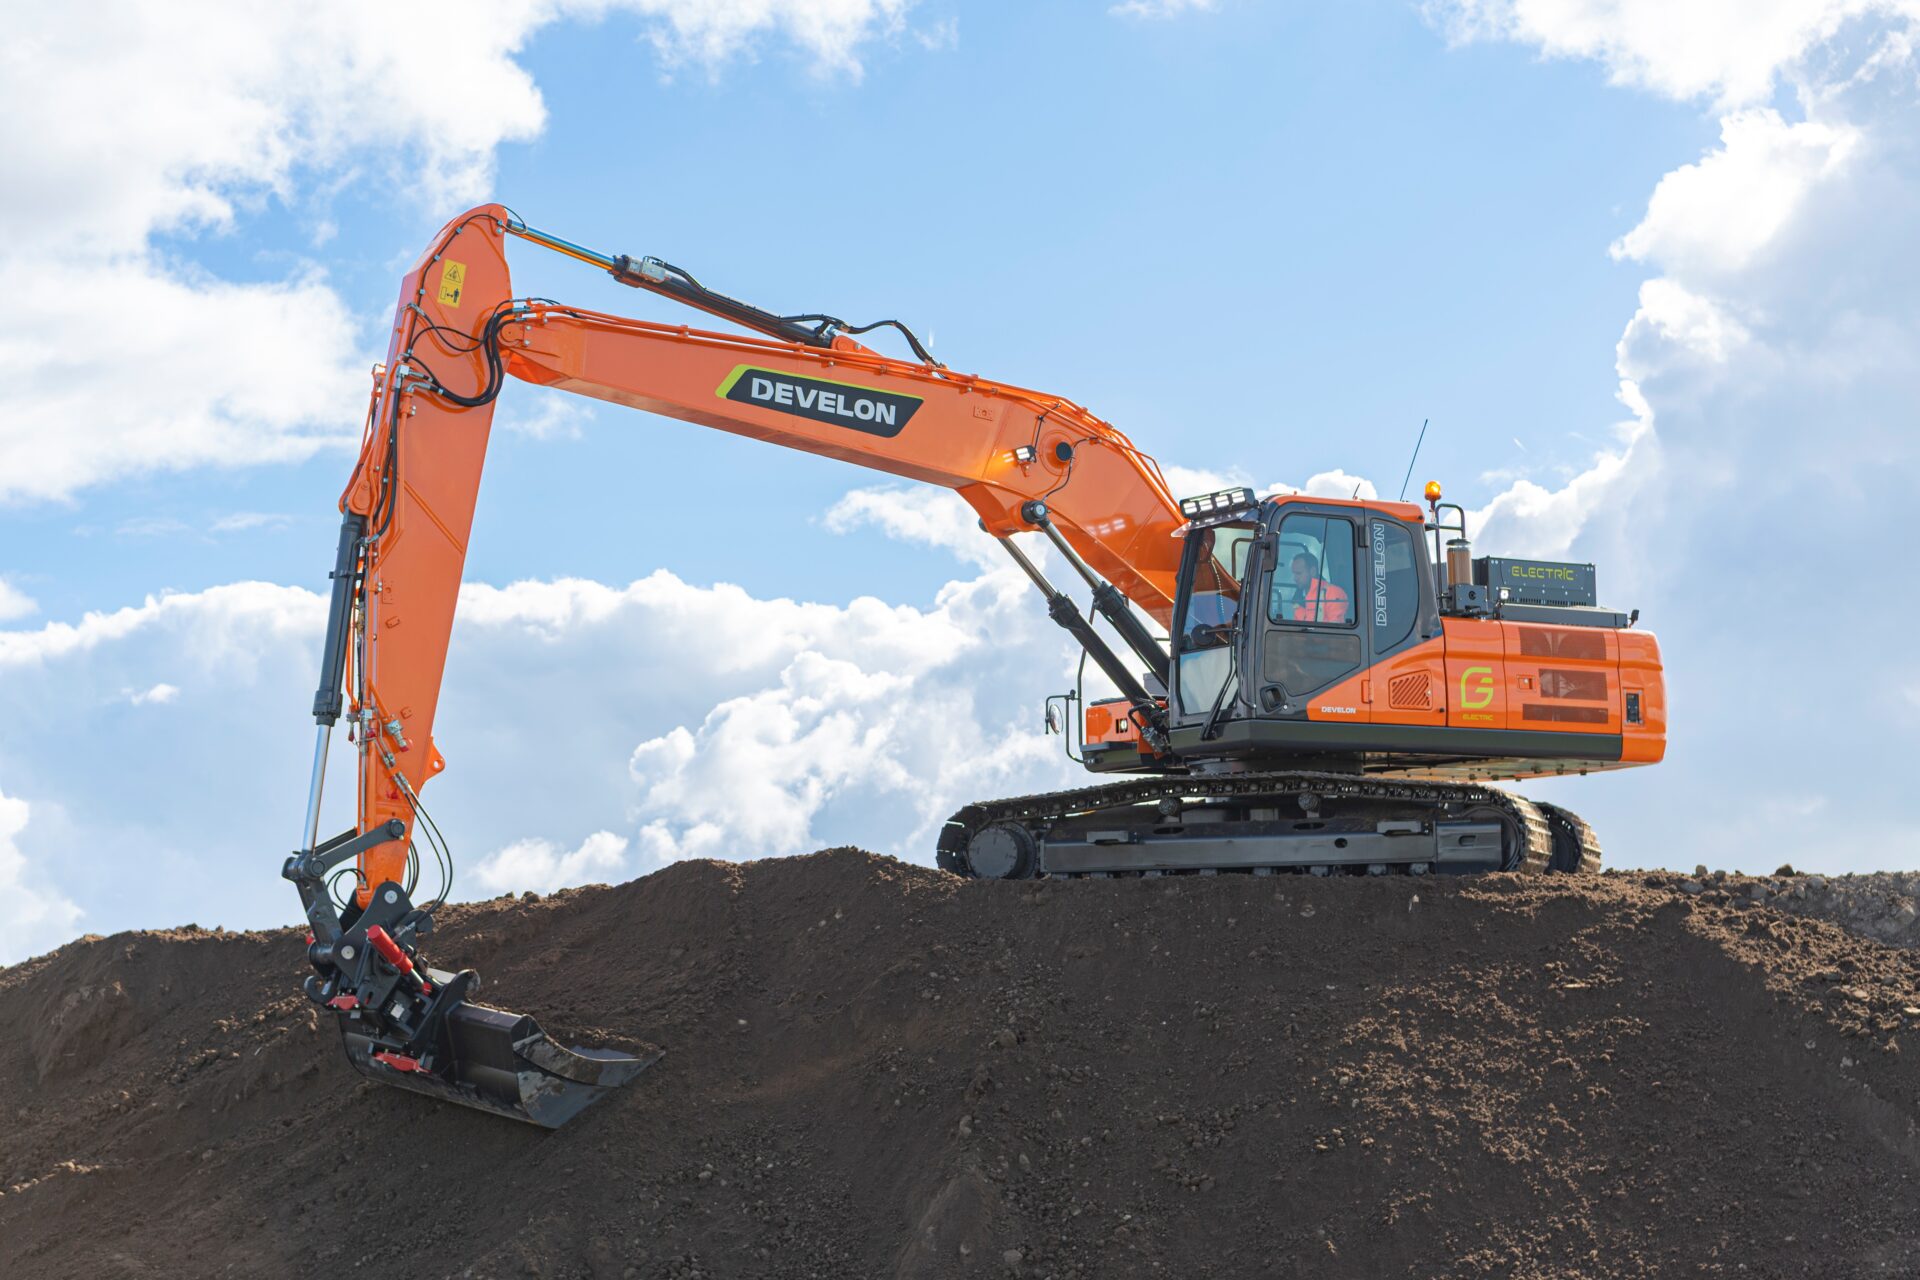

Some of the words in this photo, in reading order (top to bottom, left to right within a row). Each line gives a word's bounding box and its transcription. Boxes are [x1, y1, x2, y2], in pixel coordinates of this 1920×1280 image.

[751, 377, 896, 425] DEVELON
[1373, 523, 1387, 626] DEVELON
[1511, 566, 1574, 580] ELECTRIC
[1321, 706, 1356, 714] DEVELON
